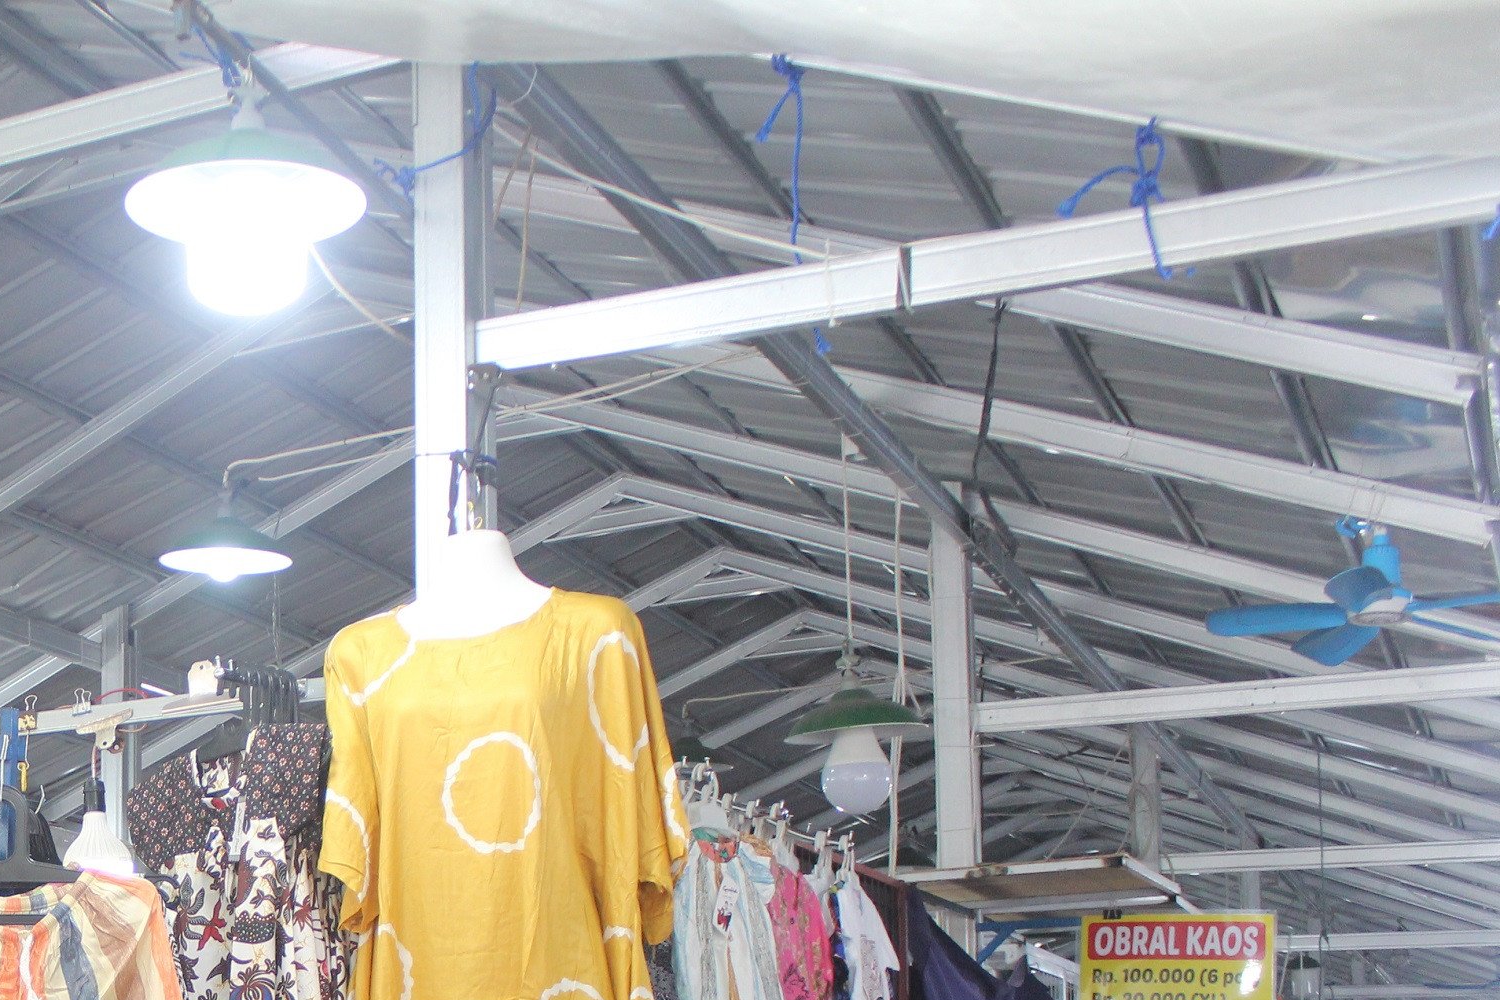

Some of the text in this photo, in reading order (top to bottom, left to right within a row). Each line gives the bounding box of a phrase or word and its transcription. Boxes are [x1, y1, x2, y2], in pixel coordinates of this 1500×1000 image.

[1094, 925, 1259, 957] OBRAL KAOS
[1092, 969, 1117, 986] Rp.
[1123, 968, 1195, 984] 100.000
